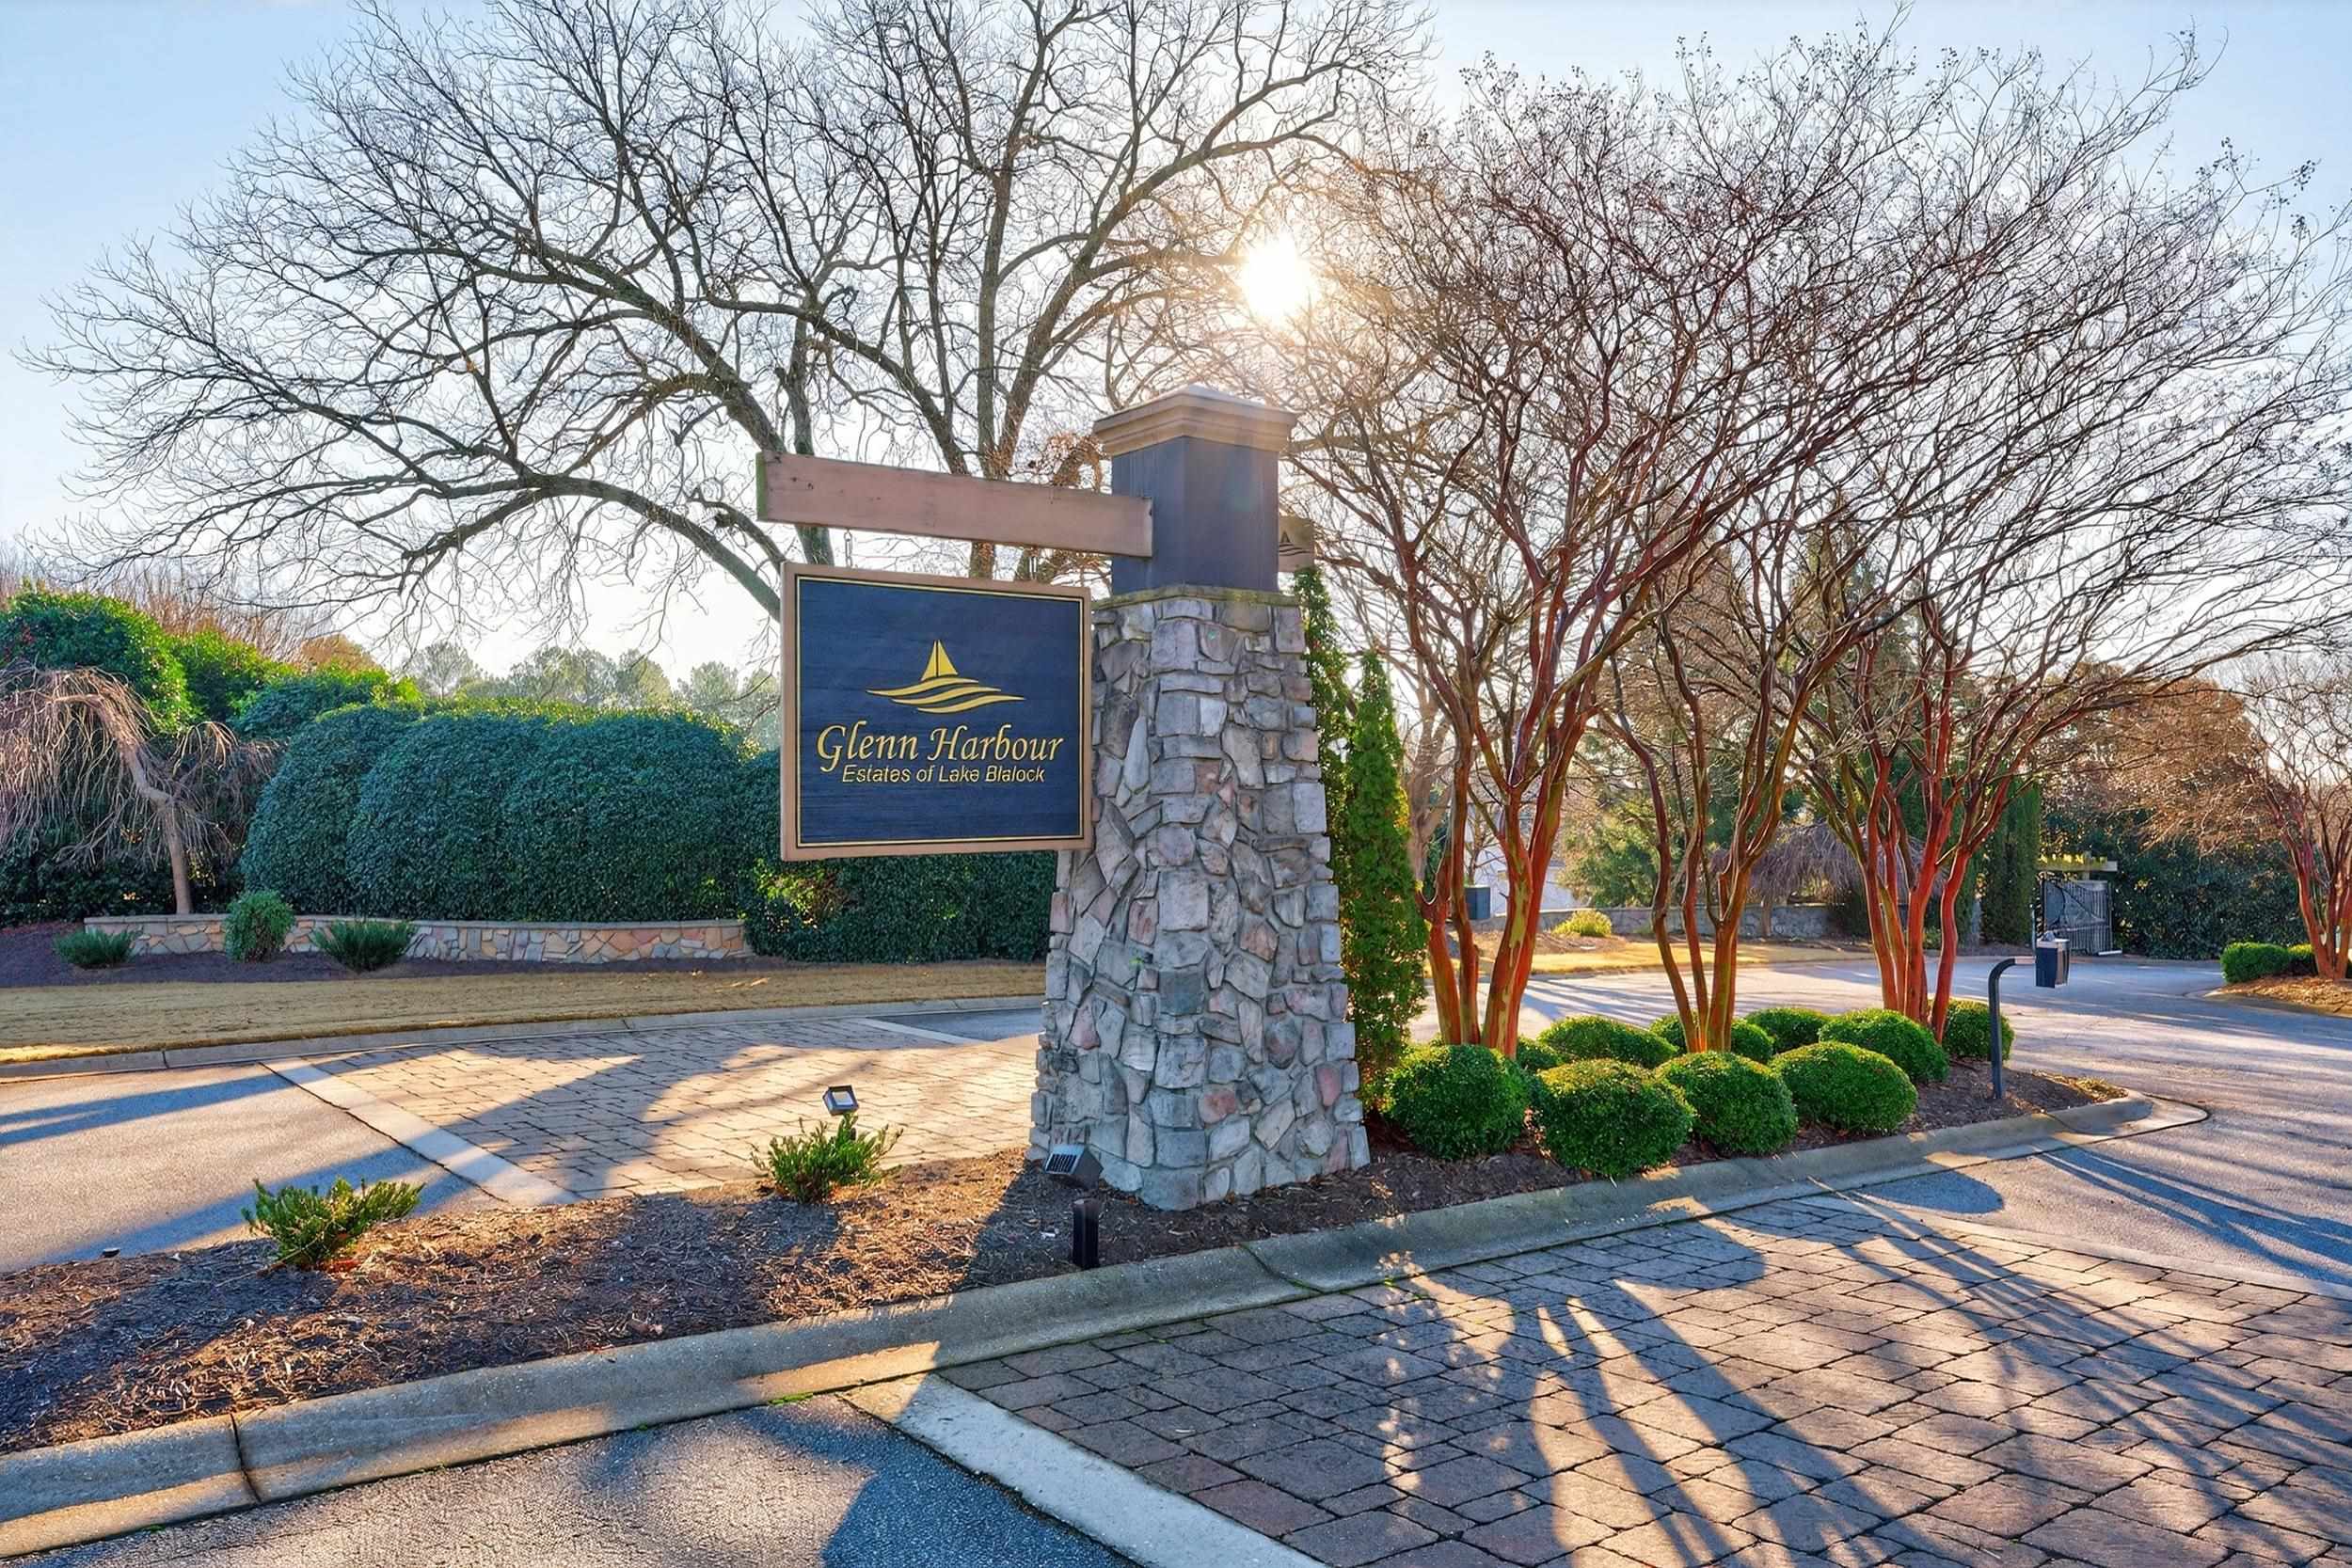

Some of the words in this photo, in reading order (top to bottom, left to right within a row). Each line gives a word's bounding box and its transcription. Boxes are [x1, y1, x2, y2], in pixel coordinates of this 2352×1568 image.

[816, 720, 919, 772] Glenn
[927, 723, 1064, 761] Harbour
[842, 764, 911, 784] Estates
[915, 764, 934, 783] of
[939, 765, 979, 783] Lake
[985, 765, 1046, 783] Blalock
